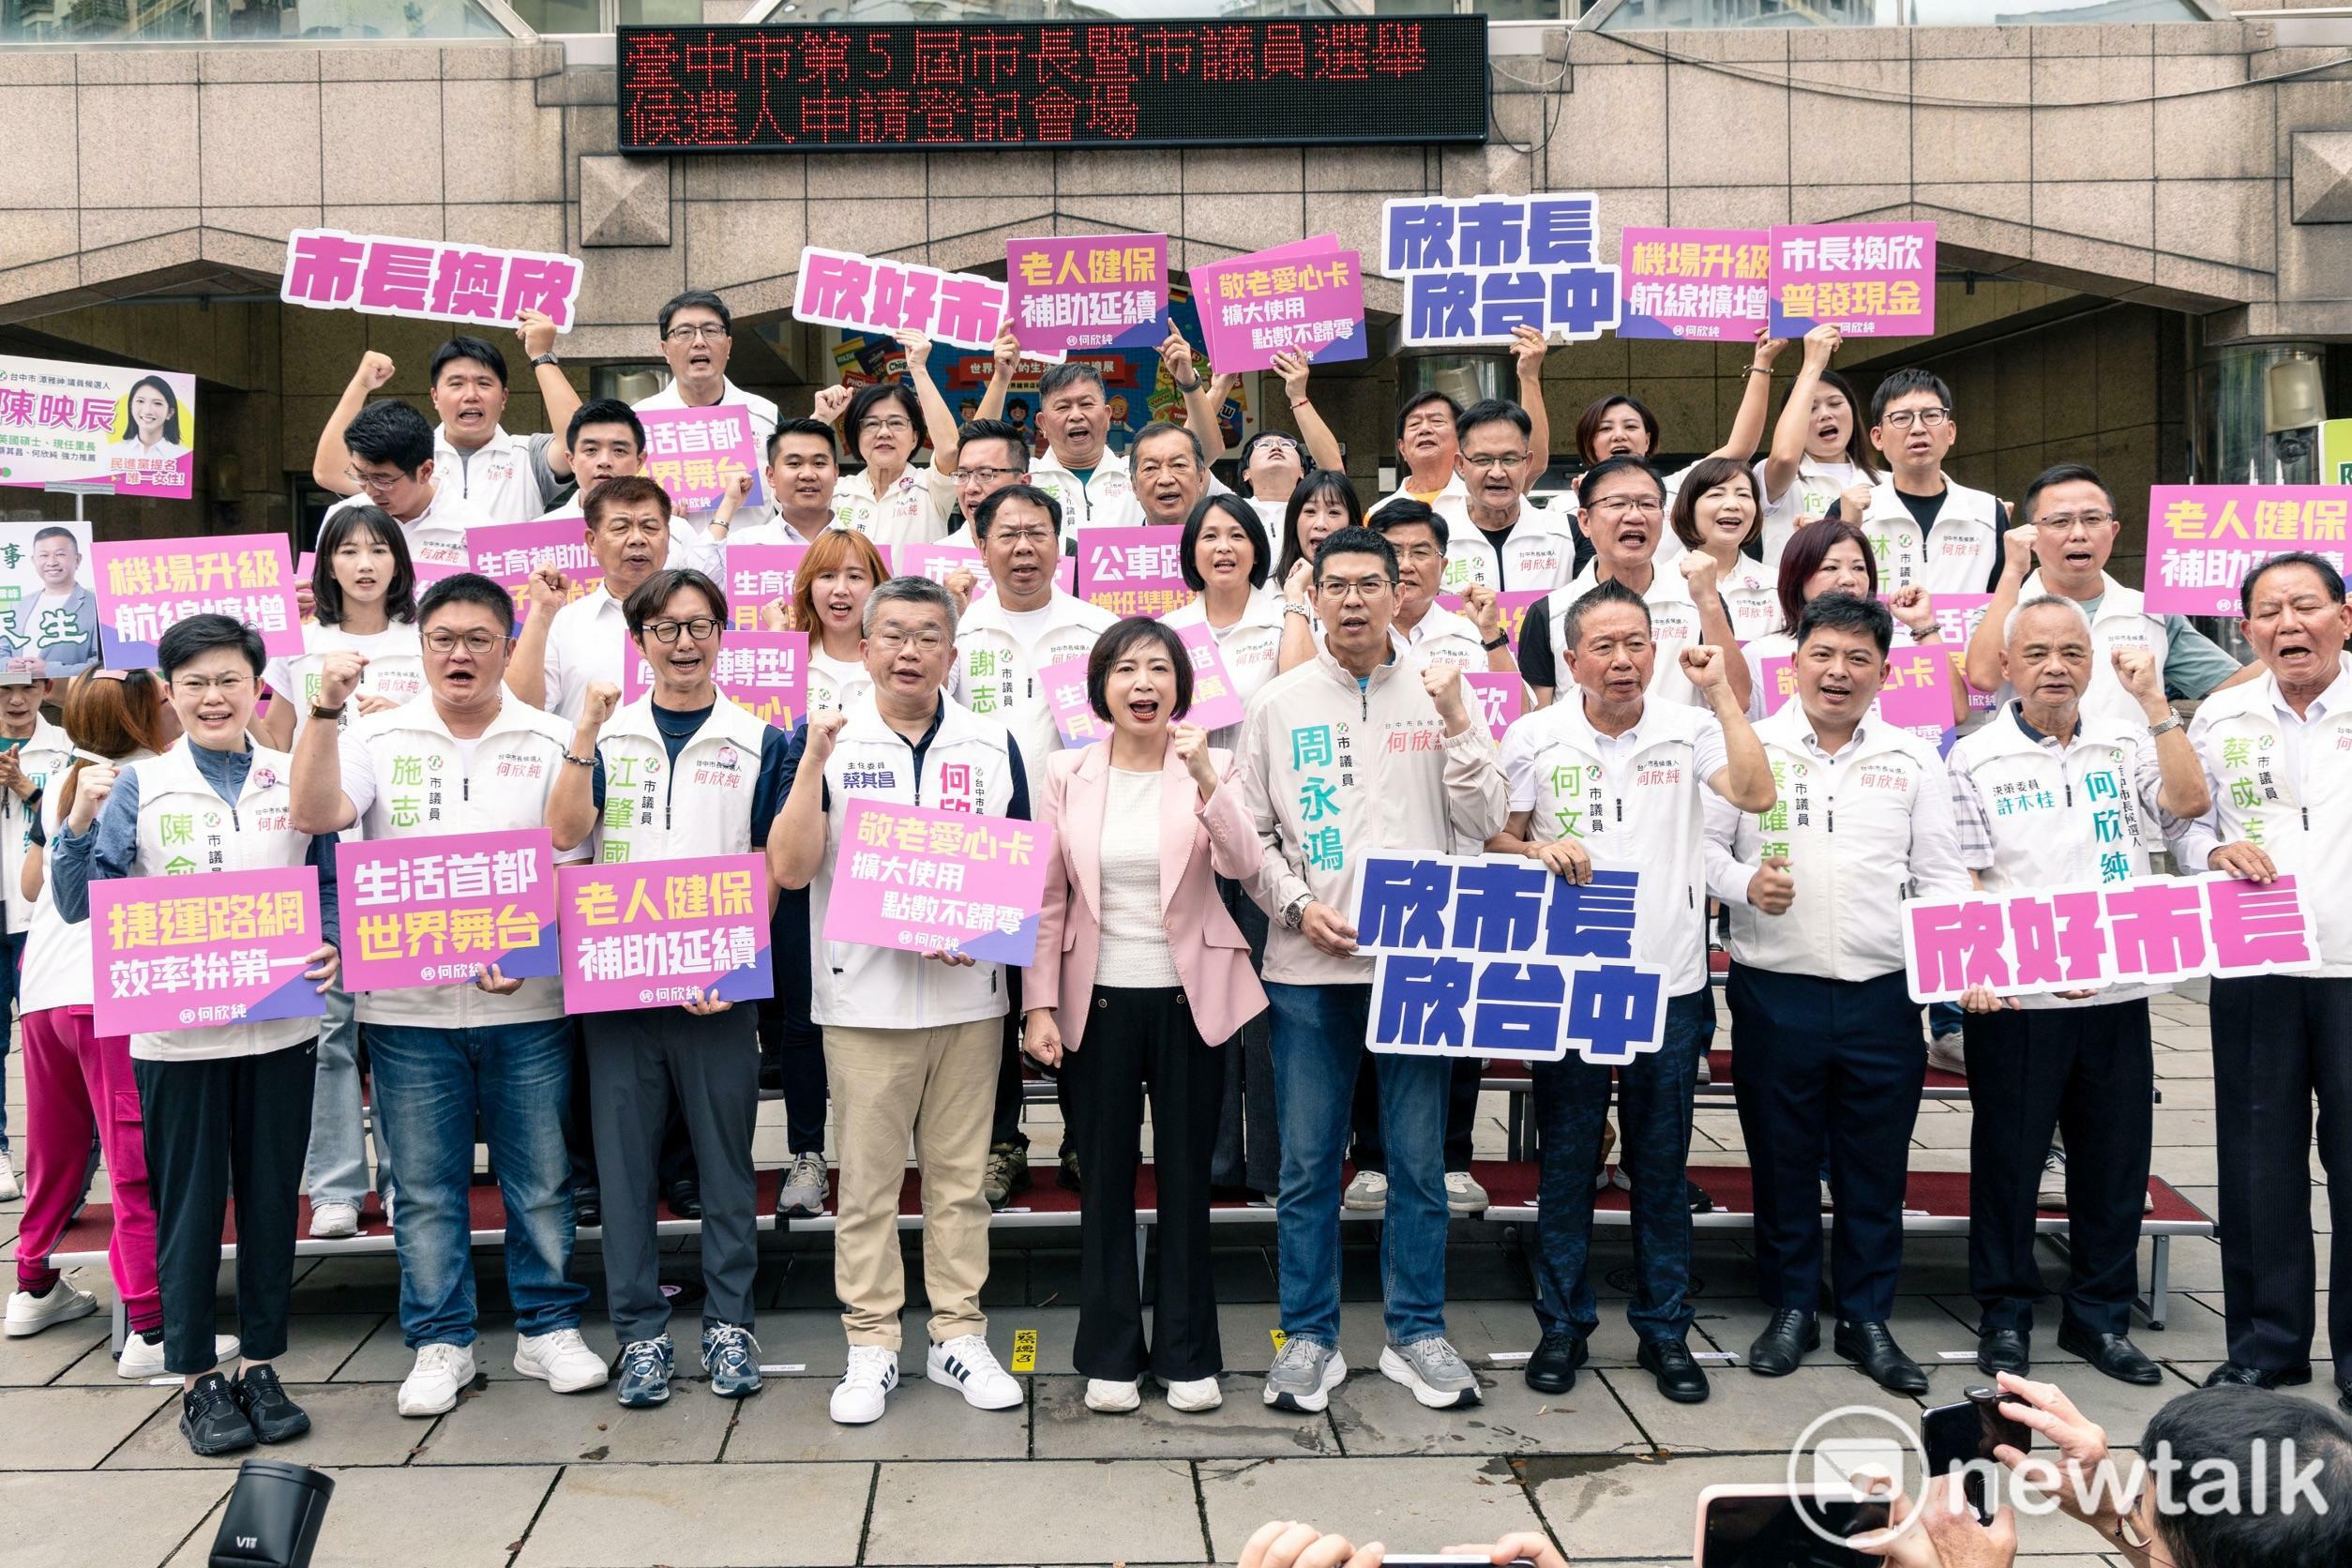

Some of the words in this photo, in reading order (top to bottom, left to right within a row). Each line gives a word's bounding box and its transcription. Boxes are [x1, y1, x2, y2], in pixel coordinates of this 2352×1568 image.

[626, 85, 1138, 147] 候選人申請登記會場
[1389, 200, 1592, 270] 欣市長
[1782, 234, 1923, 272] 市長換欣
[288, 235, 576, 326] 市長換欣
[1019, 247, 1156, 286] 老人健保
[1632, 241, 1769, 279] 機場升級
[800, 253, 1004, 343] 欣好市
[1218, 264, 1350, 300] 敬老愛心卡
[1629, 282, 1769, 320] 航線擴增
[1781, 280, 1922, 318] 普發現金
[1019, 290, 1156, 329] 補助延續
[1221, 296, 1305, 327] 擴大使用
[1410, 269, 1614, 339] 欣台中
[1079, 334, 1113, 347] 何欣純
[1251, 317, 1355, 351] 點數不歸零
[1685, 324, 1721, 338] 何欣純
[1840, 321, 1876, 335] 何欣純
[0, 388, 118, 432] 陳映辰
[638, 456, 746, 491] 界舞台
[2164, 500, 2347, 541] 老人健保
[107, 549, 281, 596] 機場升級
[2161, 549, 2344, 589] 補助
[1738, 606, 1774, 619] 何欣純
[378, 678, 421, 695] 何欣純
[1002, 669, 1014, 707] 市議員
[496, 761, 543, 779] 何欣純
[694, 769, 743, 790] 何欣純
[842, 771, 897, 790] 蔡其昌
[1337, 736, 1354, 787] 市議員
[1637, 767, 1681, 787] 何欣純
[2257, 756, 2280, 800] 市議員
[428, 777, 443, 822] 市議員
[641, 779, 656, 825] 市議員
[1290, 723, 1344, 871] 周永鴻
[1861, 774, 1909, 792] 何欣純
[1992, 778, 2041, 797] 決策委員
[600, 757, 639, 864] 江肇國
[1589, 787, 1604, 833] 市議員
[1794, 782, 1810, 827] 市議員
[1996, 791, 2056, 817] 許木桂
[856, 810, 1035, 867] 敬老愛心卡
[2085, 770, 2132, 883] 何欣純
[354, 848, 539, 907] 生活首都
[850, 851, 966, 893] 擴大使用
[574, 870, 754, 927] 老人健保
[881, 890, 1025, 936] 點數不歸零
[1355, 858, 1640, 959] 欣市長
[107, 890, 306, 951] 捷運路網
[356, 904, 541, 961] 世界舞台
[1911, 873, 2312, 995] 欣好市長
[577, 926, 757, 982] 補助延續
[914, 931, 960, 952] 何欣純
[197, 1003, 248, 1022] 何欣純
[656, 985, 701, 1002] 何欣純
[1376, 954, 1662, 1056] 欣台中
